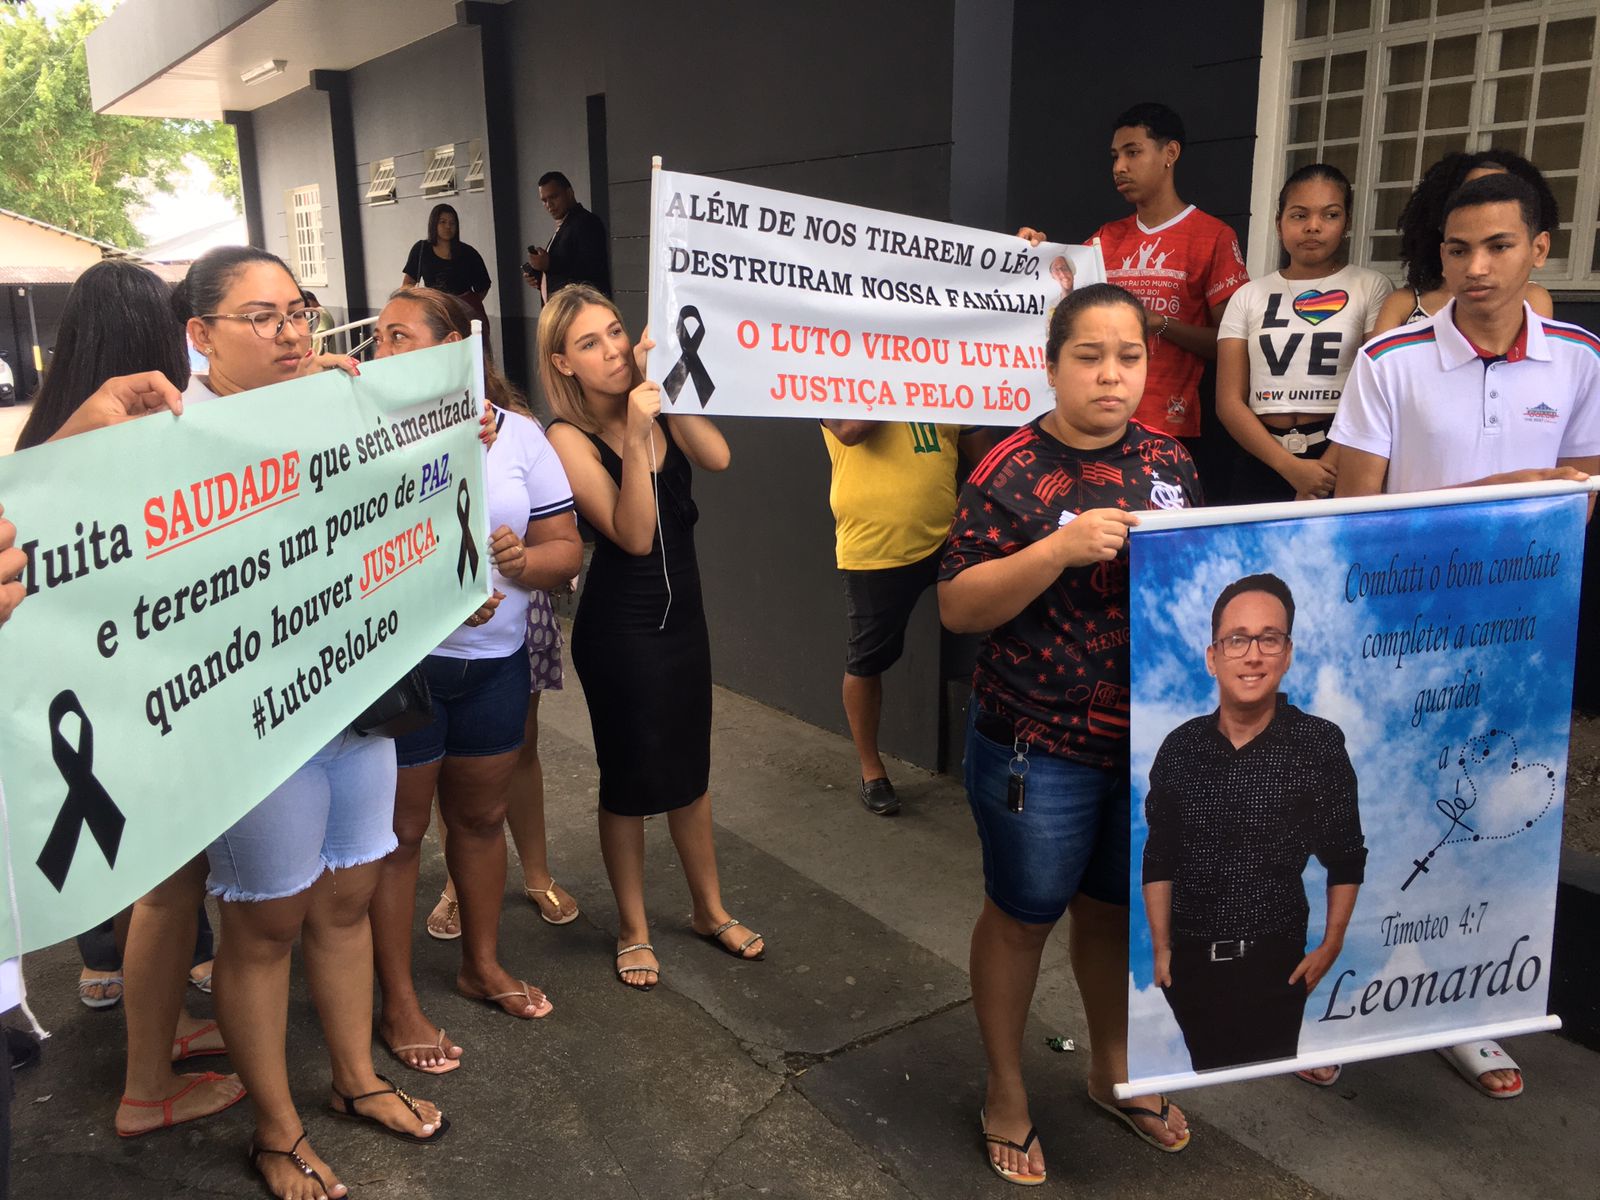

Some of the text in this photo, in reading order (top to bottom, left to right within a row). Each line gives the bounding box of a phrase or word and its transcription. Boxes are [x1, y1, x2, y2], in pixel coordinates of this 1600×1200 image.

[665, 191, 1040, 281] ALÉM DE NOS TIRAREM O LÉO,
[668, 246, 1046, 316] DESTRUIRAM NOSSA FAMÍLIA!
[736, 319, 1046, 370] O LUTO VIROU LUTA!!
[770, 373, 1031, 412] JUSTIÇA PELO LÉO
[1256, 390, 1342, 401] NOW UNITED
[144, 450, 301, 550] SAUDADE
[309, 447, 351, 494] que
[356, 416, 394, 464] será
[391, 389, 478, 447] amenizada
[97, 452, 453, 658] e teremos um pouco de PAZ,
[1344, 539, 1561, 603] Combati o bom combate
[144, 517, 440, 736] quando houver JUSTIÇA.
[1362, 606, 1537, 669] completei a carreira
[252, 609, 399, 740] #LutoPeloLeo
[1411, 669, 1484, 728] guardei
[1438, 745, 1450, 770] a
[1380, 902, 1488, 948] Timoteo 4:7
[1318, 935, 1542, 1023] Leonardo
